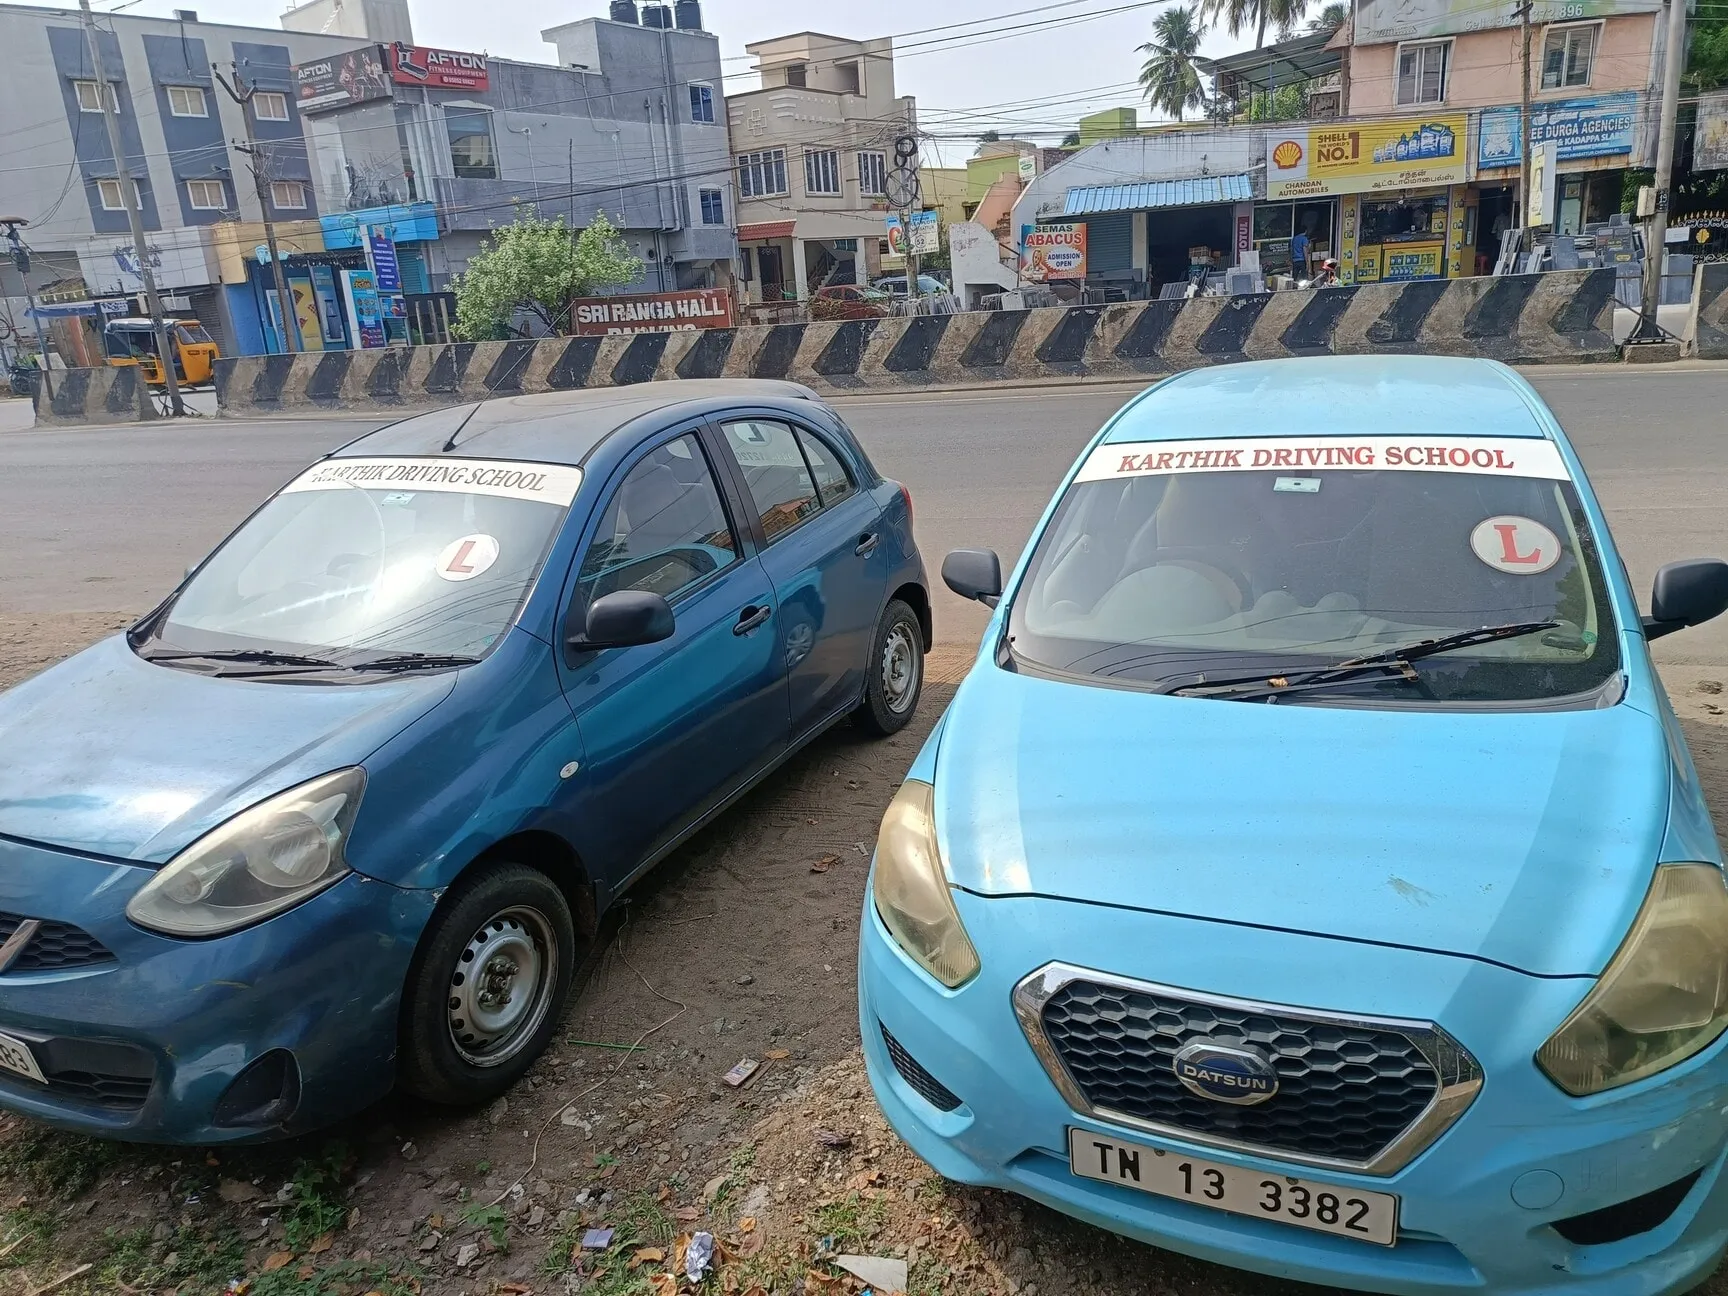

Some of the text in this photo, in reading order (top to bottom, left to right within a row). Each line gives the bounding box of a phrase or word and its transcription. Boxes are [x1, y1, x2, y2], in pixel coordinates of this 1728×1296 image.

[1560, 4, 1583, 18] 896
[427, 51, 487, 70] AFTON
[298, 62, 333, 79] AFTON
[428, 65, 486, 78] FITNESS EQUIPMENT
[1546, 122, 1579, 138] DURGA
[1582, 116, 1631, 134] AGENCIES
[1318, 132, 1347, 143] SHELL
[1564, 135, 1600, 146] KADAPPA
[1279, 186, 1329, 197] AUTOMOBILES
[1285, 180, 1322, 189] CHANDAN
[1035, 224, 1073, 233] SEMAS
[1238, 221, 1248, 253] OTUL
[1025, 232, 1082, 246] ABACUS
[1047, 252, 1080, 260] ADMISSION
[1055, 260, 1072, 268] OPEN
[577, 297, 726, 323] SRI RANGA HALL
[1116, 446, 1515, 473] KARTHIK DRIVING SCHOOL
[386, 465, 468, 483] DRIVING
[465, 469, 548, 491] SCHOOL
[1493, 524, 1542, 564] L
[445, 540, 477, 573] L
[0, 1044, 30, 1072] 83
[1183, 1064, 1267, 1090] DATSUN
[1092, 1141, 1370, 1233] TN 13 3382
